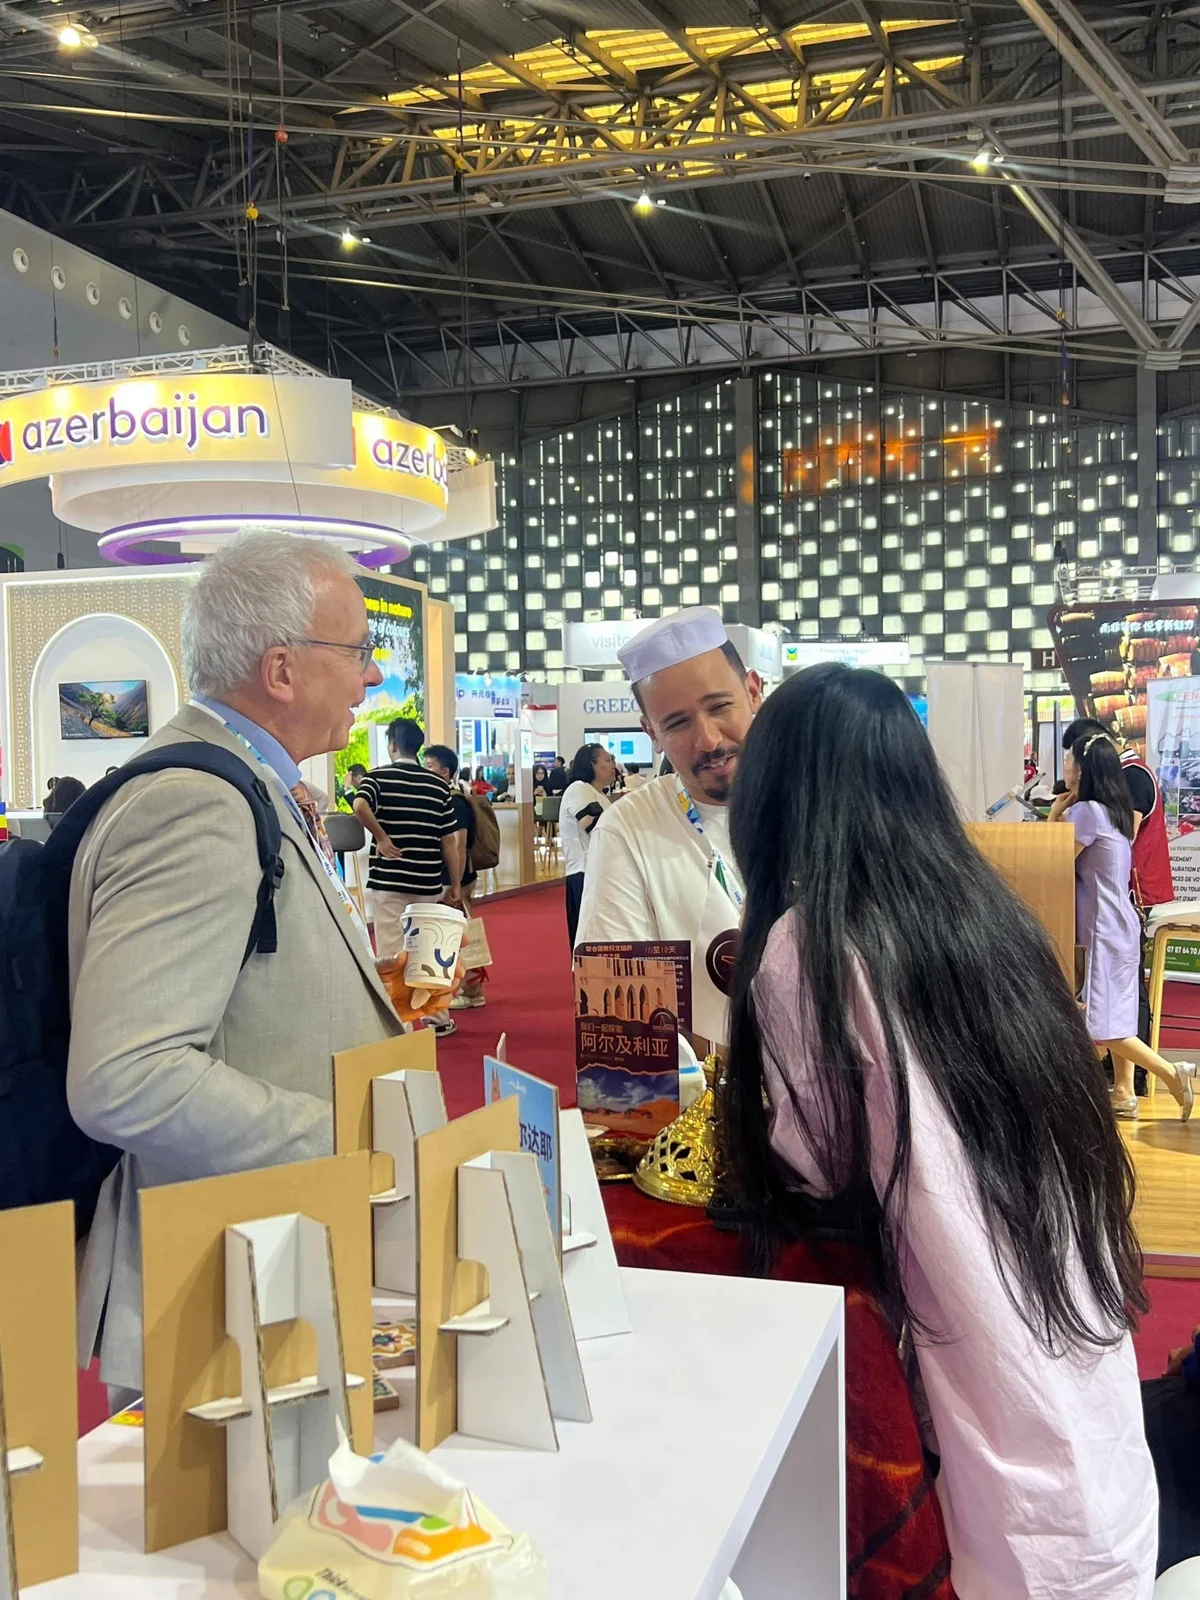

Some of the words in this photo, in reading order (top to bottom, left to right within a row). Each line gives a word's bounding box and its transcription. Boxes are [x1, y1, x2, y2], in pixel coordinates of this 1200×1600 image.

[22, 393, 266, 448] azerbaijan
[1042, 651, 1055, 667] H
[581, 1032, 669, 1058] 阿尔及利亚
